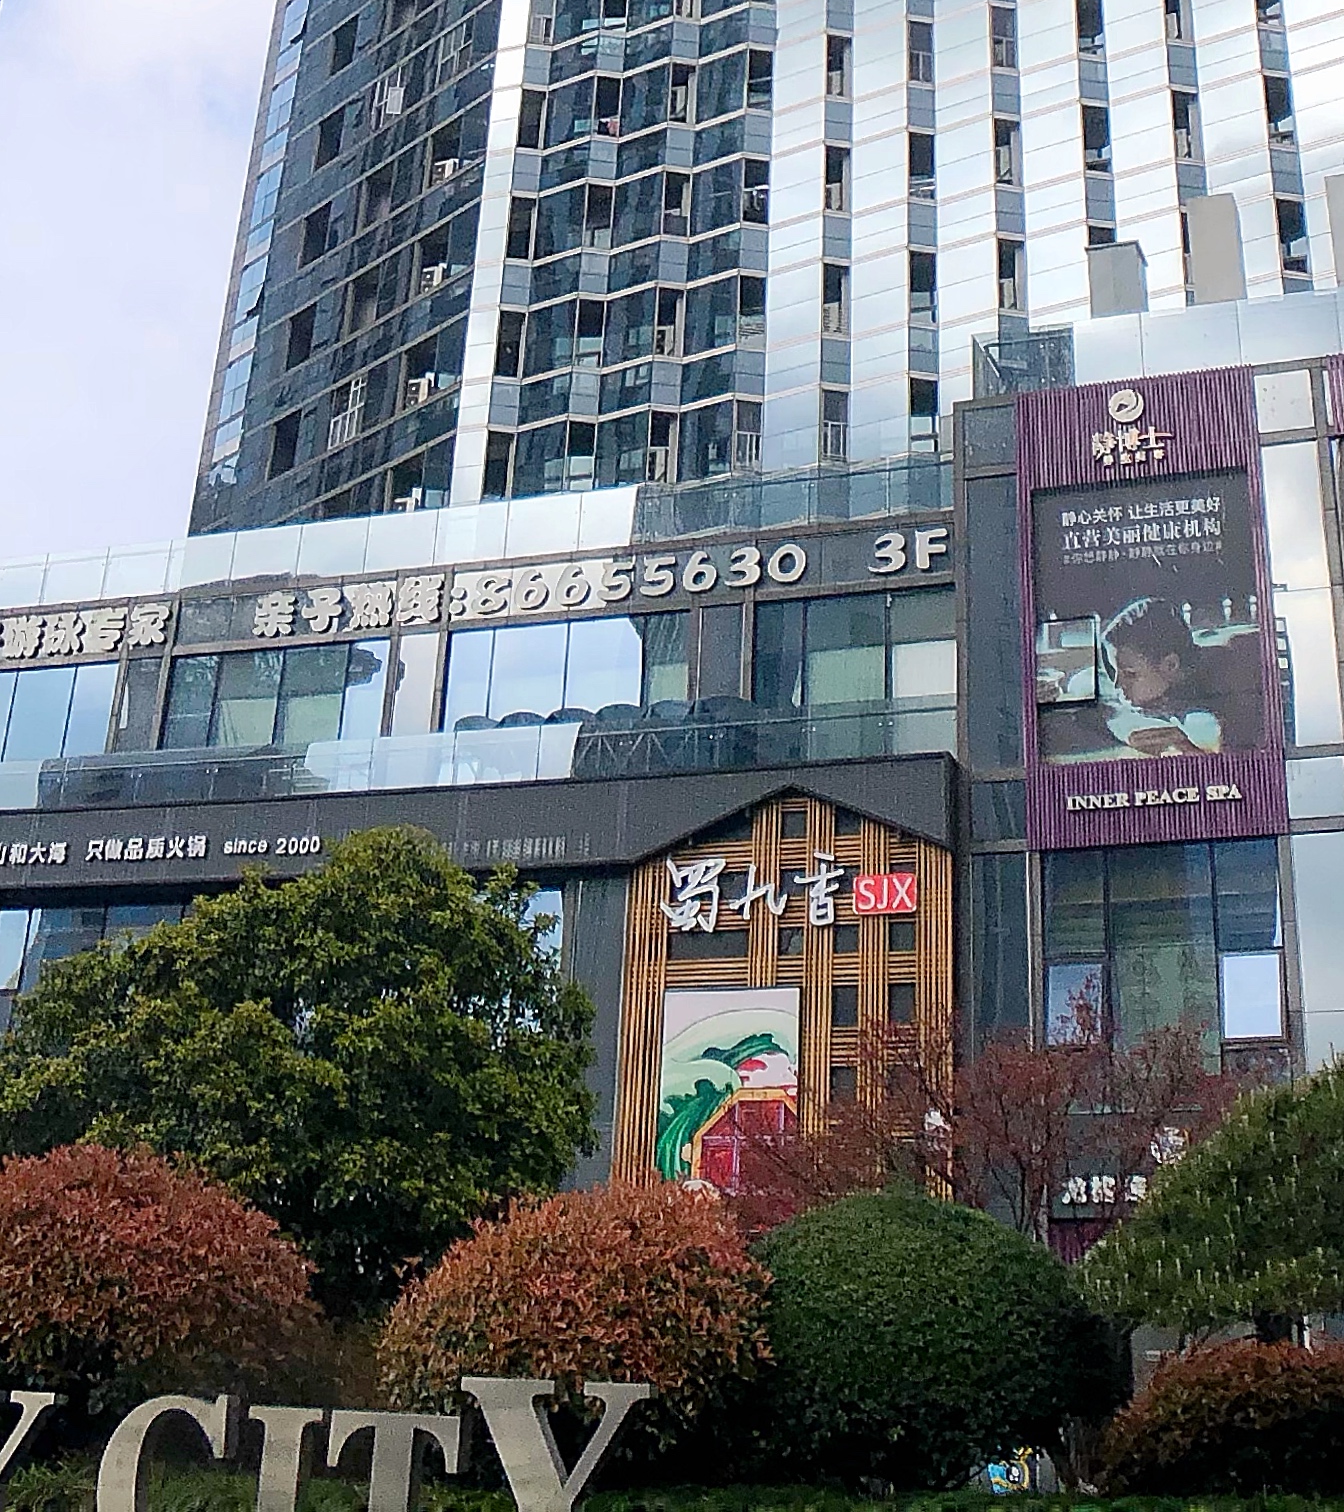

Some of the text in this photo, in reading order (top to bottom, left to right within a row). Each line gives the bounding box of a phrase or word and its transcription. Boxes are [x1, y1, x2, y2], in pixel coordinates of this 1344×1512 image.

[1061, 496, 1221, 527] 静心关怀 让生活更美好
[1061, 517, 1222, 550] 直营美丽健康机构
[867, 527, 949, 574] 3F
[1066, 783, 1243, 811] INNER PEACE SPA
[85, 834, 208, 861] 只做品质火锅
[223, 837, 268, 855] since
[274, 836, 321, 855] 2000
[660, 851, 916, 933] 蜀九香 SJX
[96, 1376, 653, 1512] CITY
